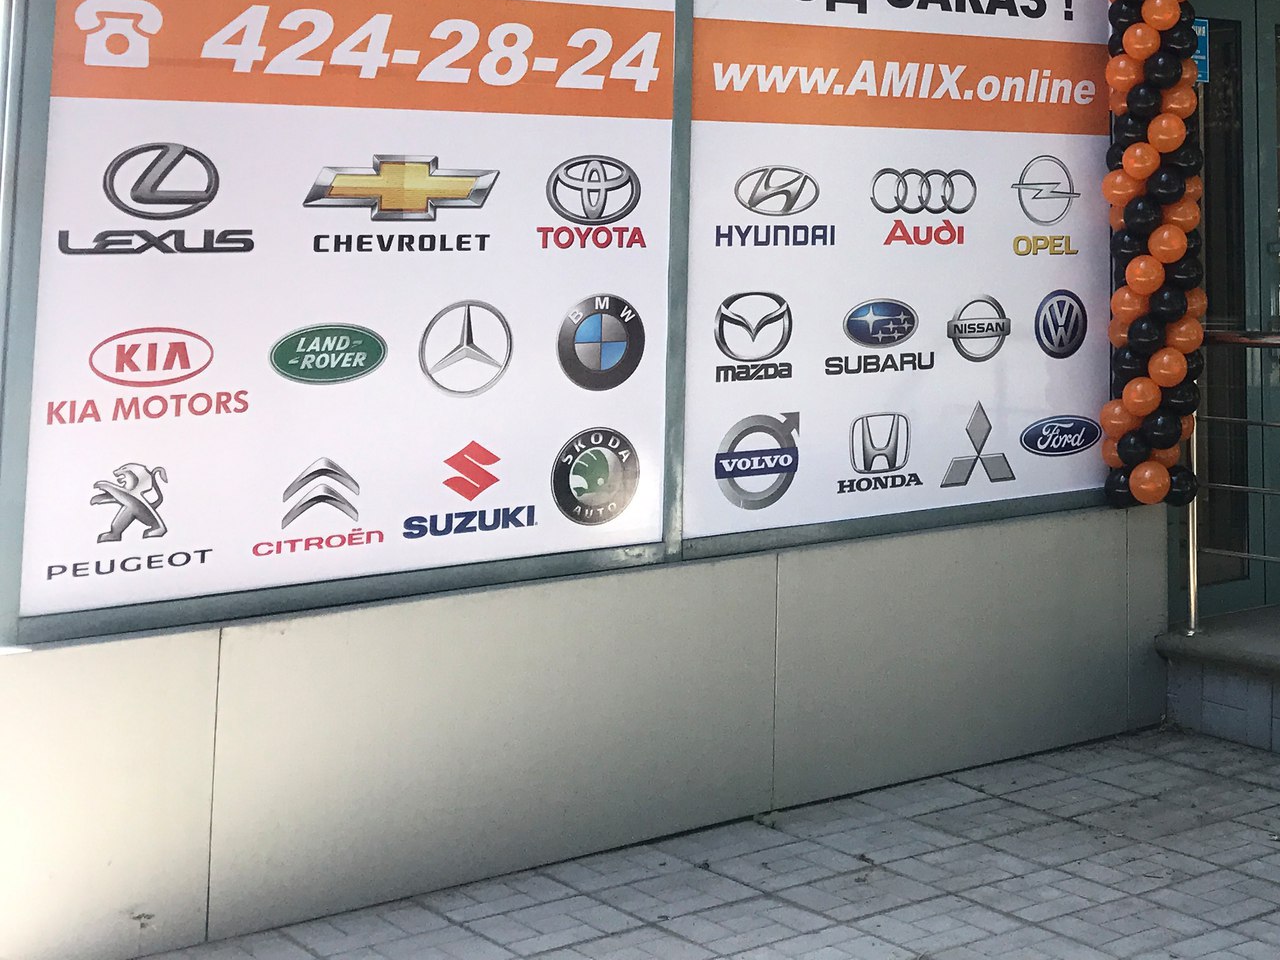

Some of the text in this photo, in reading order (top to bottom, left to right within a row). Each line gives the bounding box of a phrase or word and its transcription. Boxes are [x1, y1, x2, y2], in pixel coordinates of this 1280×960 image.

[201, 4, 662, 93] 424-28-24
[712, 60, 1096, 105] www.AMIX.online
[58, 229, 255, 255] LEXUS
[313, 233, 491, 253] CHEVROLET
[536, 226, 647, 250] TOYOTA
[715, 225, 836, 247] HYUNDAI
[883, 219, 965, 246] Audi
[1012, 235, 1079, 257] OPEL
[568, 296, 636, 326] BMW
[953, 320, 1005, 336] NISSAN
[115, 341, 191, 374] KIA
[825, 352, 935, 376] SUBARU
[46, 389, 250, 426] KIA MOTORS
[1036, 422, 1086, 449] Ford
[719, 453, 794, 472] VOLVO
[837, 473, 924, 495] HONDA
[403, 504, 536, 540] SUZUKI
[573, 501, 618, 519] AUTO
[46, 548, 213, 582] PEUGEOT
